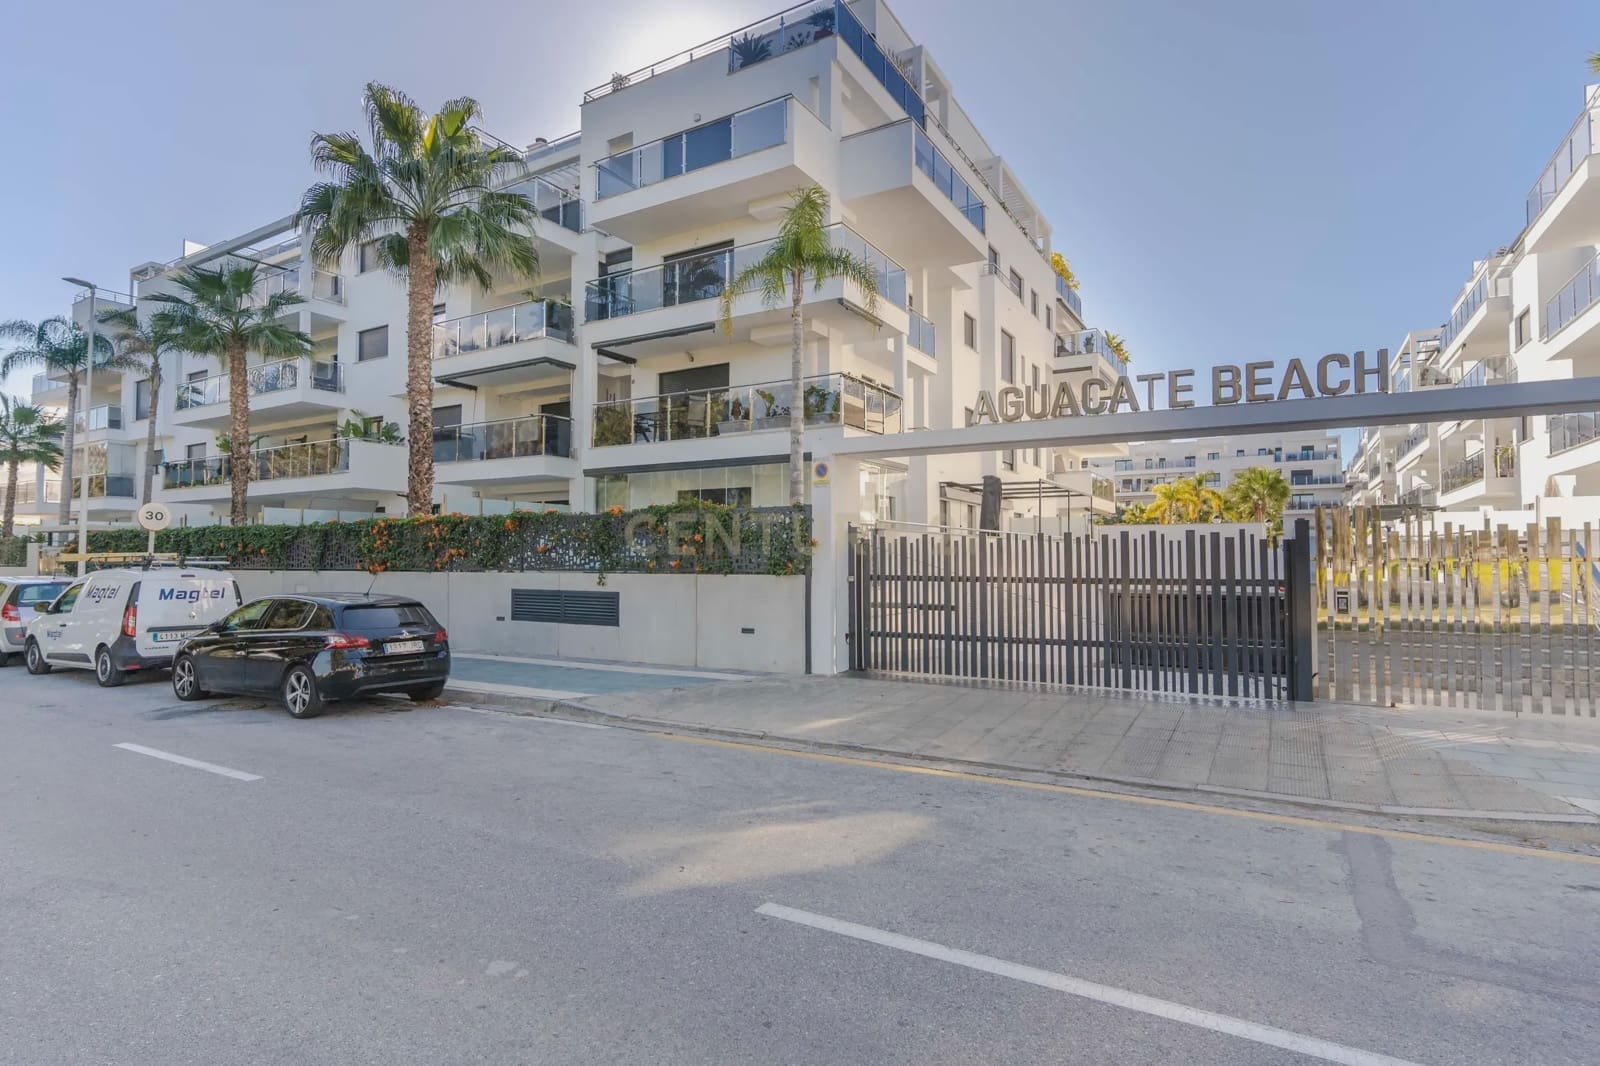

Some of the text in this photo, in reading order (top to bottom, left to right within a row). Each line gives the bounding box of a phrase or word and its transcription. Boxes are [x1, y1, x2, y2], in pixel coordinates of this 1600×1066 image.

[971, 348, 1389, 424] AGUACATE BEACH
[145, 510, 164, 521] 30
[86, 585, 120, 603] Magtel
[159, 587, 225, 603] Magtel
